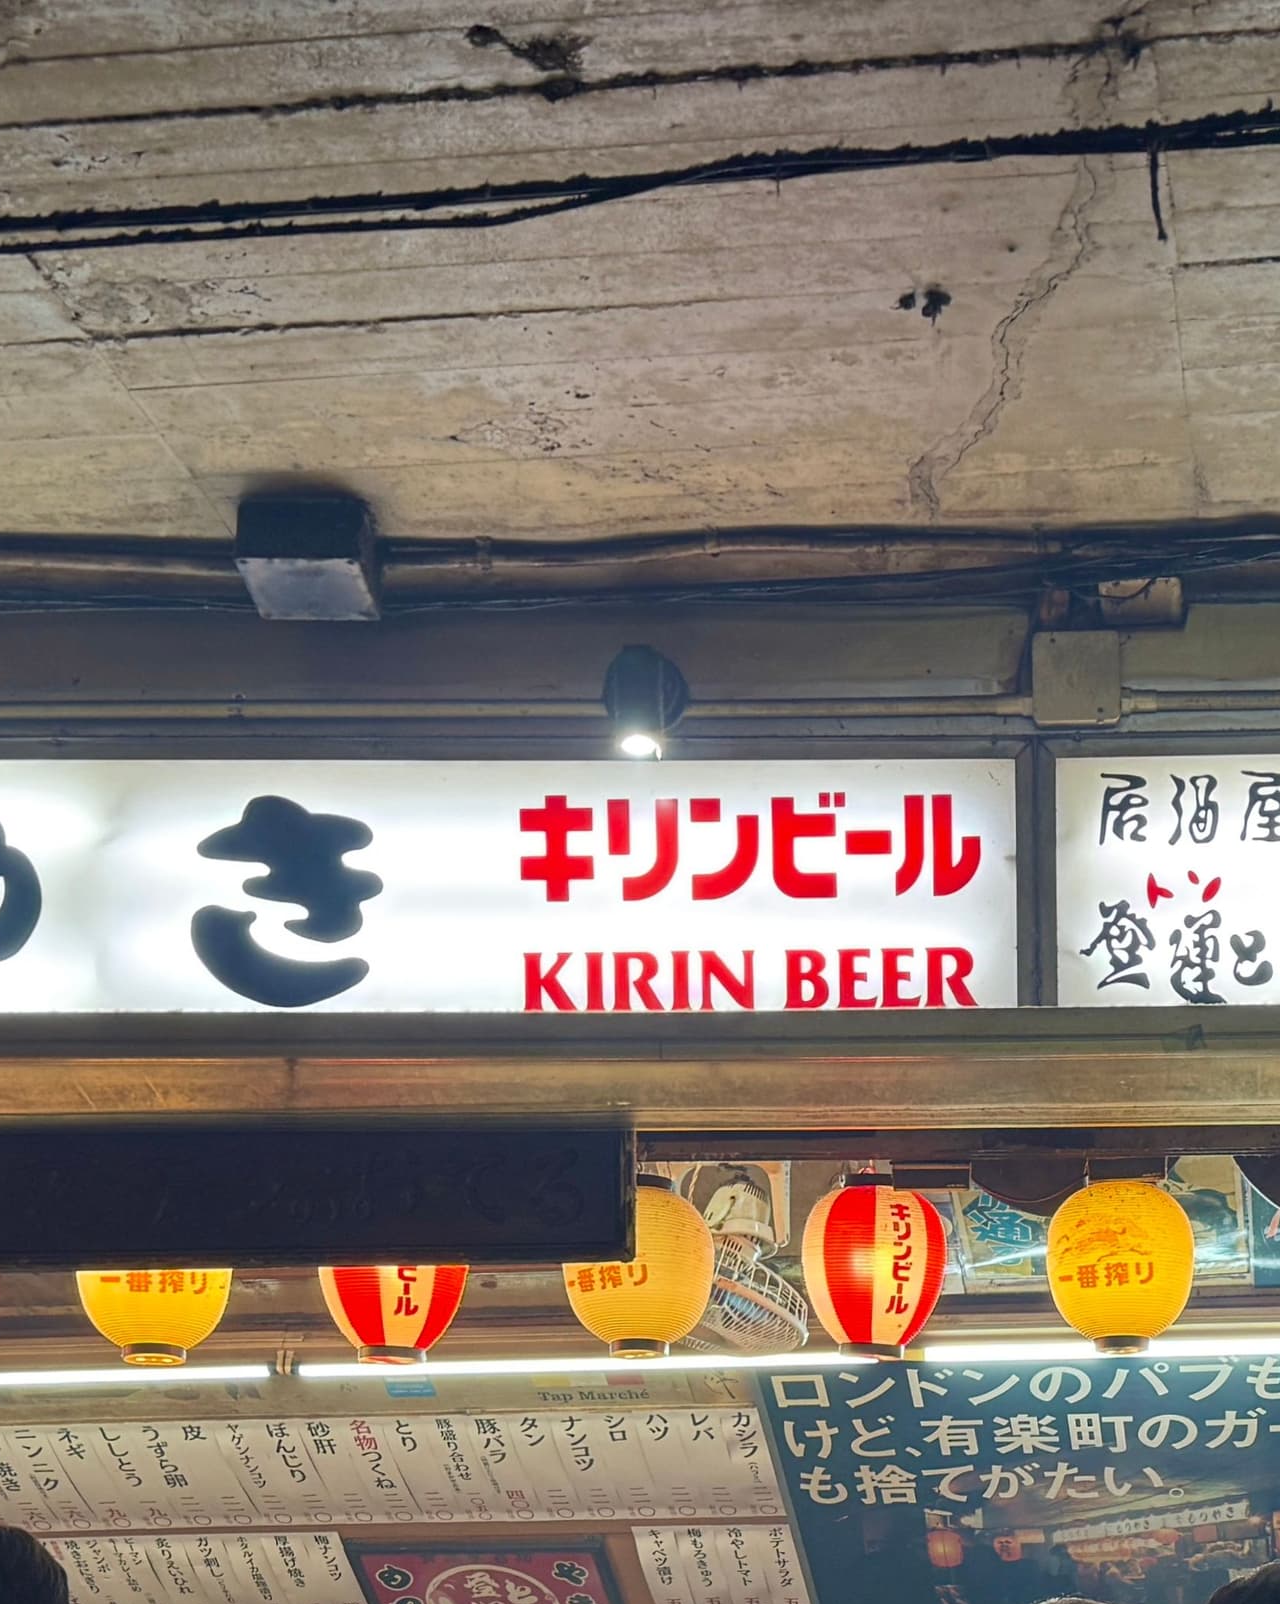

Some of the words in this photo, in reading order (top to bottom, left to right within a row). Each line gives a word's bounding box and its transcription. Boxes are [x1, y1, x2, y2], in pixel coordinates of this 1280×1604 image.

[520, 793, 982, 904] キリンビール
[523, 949, 754, 1013] KIRIN
[784, 946, 981, 1011] BEER
[889, 1202, 914, 1315] キリンビール
[1057, 1260, 1156, 1289] 一番搾り
[99, 1270, 209, 1295] 一番搾り
[537, 1391, 570, 1403] Tap
[578, 1389, 650, 1401] Marché
[57, 1428, 86, 1460] ネギ
[181, 1424, 207, 1441] 皮
[305, 1421, 337, 1455] 砂肝
[395, 1419, 418, 1452] とり
[435, 1418, 472, 1481] 豚盛り合わせ
[474, 1418, 507, 1464] 豚バラ
[520, 1415, 545, 1447] タン
[560, 1415, 595, 1472] ナンコツ
[603, 1415, 628, 1442] シロ
[645, 1413, 670, 1442] ハツ
[690, 1413, 715, 1441] レバ
[731, 1411, 759, 1458] カシラ
[14, 1429, 59, 1491] ニンニク
[99, 1427, 143, 1487] ししとう
[142, 1425, 189, 1488] うずら卵
[349, 1419, 397, 1489] 名物つくね
[798, 1462, 1187, 1505] も捨てがたい。
[196, 1537, 224, 1577] ガツ刺し
[274, 1536, 305, 1587] 厚揚げ焼き
[648, 1529, 673, 1586] キャベツ漬け
[687, 1528, 713, 1587] 梅もろきゅう
[727, 1528, 752, 1586] 冷やしトマト
[769, 1528, 793, 1588] ポテトサラダ
